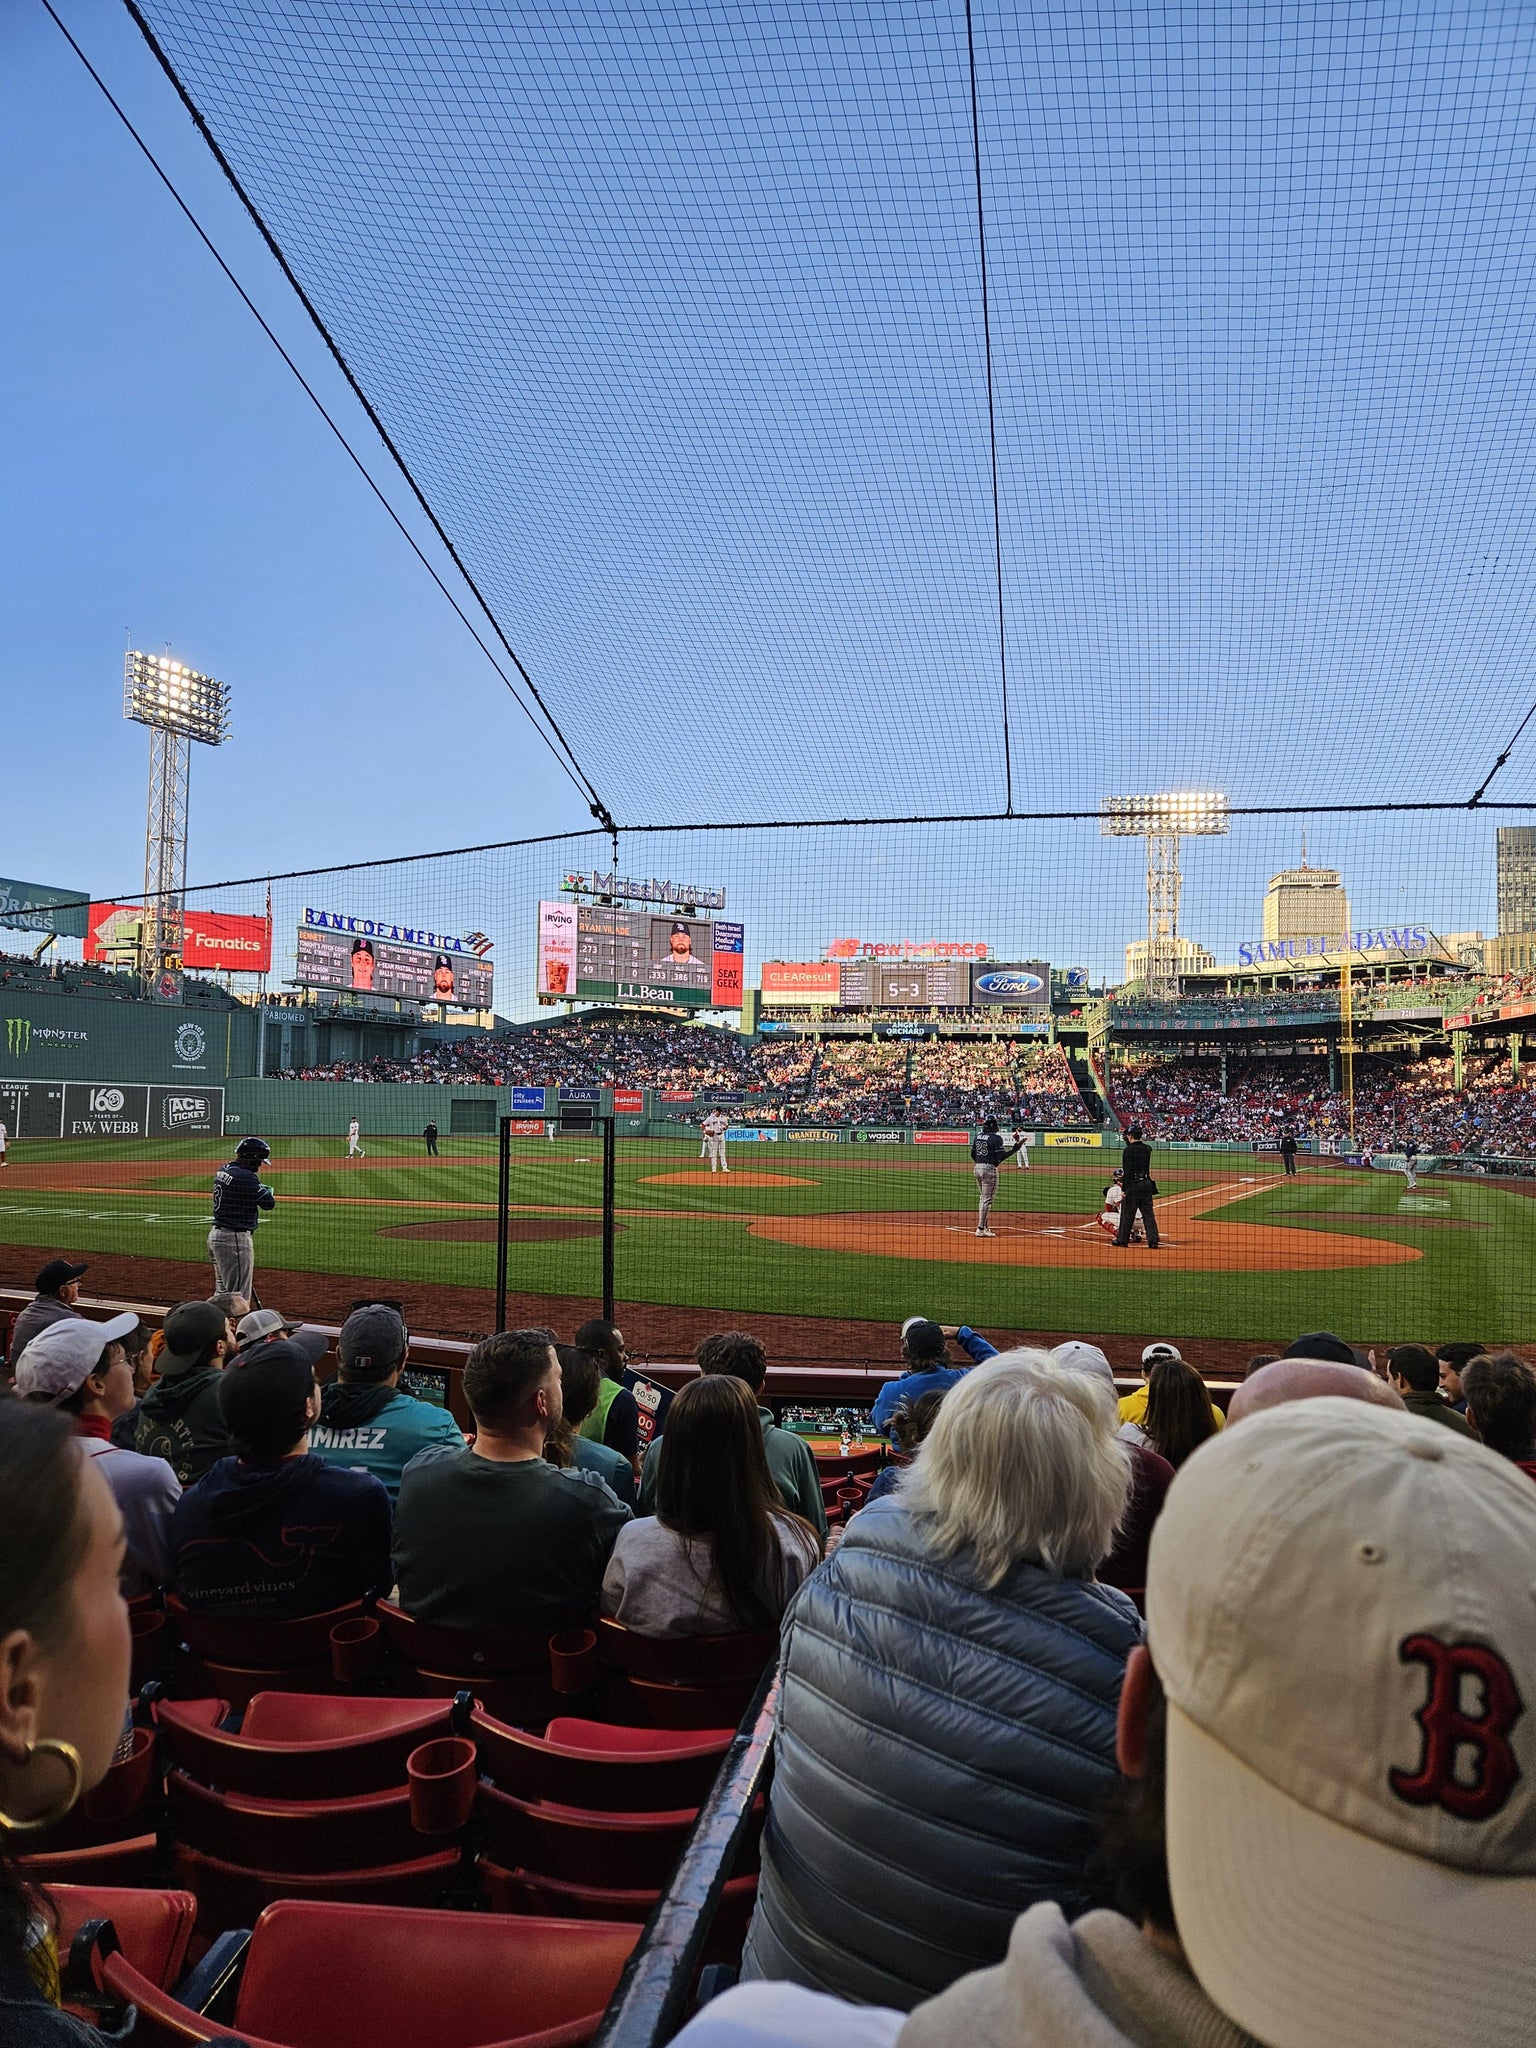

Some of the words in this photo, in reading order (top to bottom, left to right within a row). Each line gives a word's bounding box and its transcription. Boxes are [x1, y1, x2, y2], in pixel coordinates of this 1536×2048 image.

[592, 869, 726, 909] MassMutual
[544, 914, 573, 924] IRVING
[303, 907, 357, 932] BANK
[363, 920, 385, 937] OF
[389, 925, 463, 952] AMERICA
[579, 923, 601, 933] RYAN
[195, 933, 261, 952] Fanatics
[714, 937, 735, 945] Medical
[1238, 936, 1333, 967] SAMUEL
[1338, 925, 1428, 952] ADAMS
[579, 945, 598, 954] .273
[632, 949, 638, 957] 9
[863, 943, 901, 957] new
[904, 939, 988, 958] balance
[582, 965, 594, 974] 49
[632, 969, 638, 977] 0
[648, 971, 666, 979] .333
[671, 973, 688, 981] .386
[718, 969, 739, 979] SEAT
[769, 972, 833, 982] CLEAResult
[716, 979, 739, 989] GEEK
[988, 974, 1029, 992] Ford
[617, 983, 674, 1001] L.L.Bean
[269, 1011, 305, 1022] ABIOMED
[886, 1028, 925, 1036] ORCHARD
[172, 1098, 206, 1112] ACE
[172, 1110, 206, 1122] TICKET
[225, 1115, 241, 1123] 379
[72, 1121, 96, 1134] F.W.
[100, 1121, 139, 1134] WEBB
[788, 1131, 821, 1140] GRANITE
[822, 1131, 839, 1141] CITY
[868, 1132, 900, 1140] wasabi
[1055, 1136, 1079, 1145] TWISTED
[1081, 1137, 1091, 1145] TEA
[975, 1140, 989, 1156] 26
[635, 1388, 657, 1404] 50/50
[188, 1581, 251, 1600] vineyard
[254, 1579, 297, 1593] vines
[1388, 1632, 1527, 1823] B
